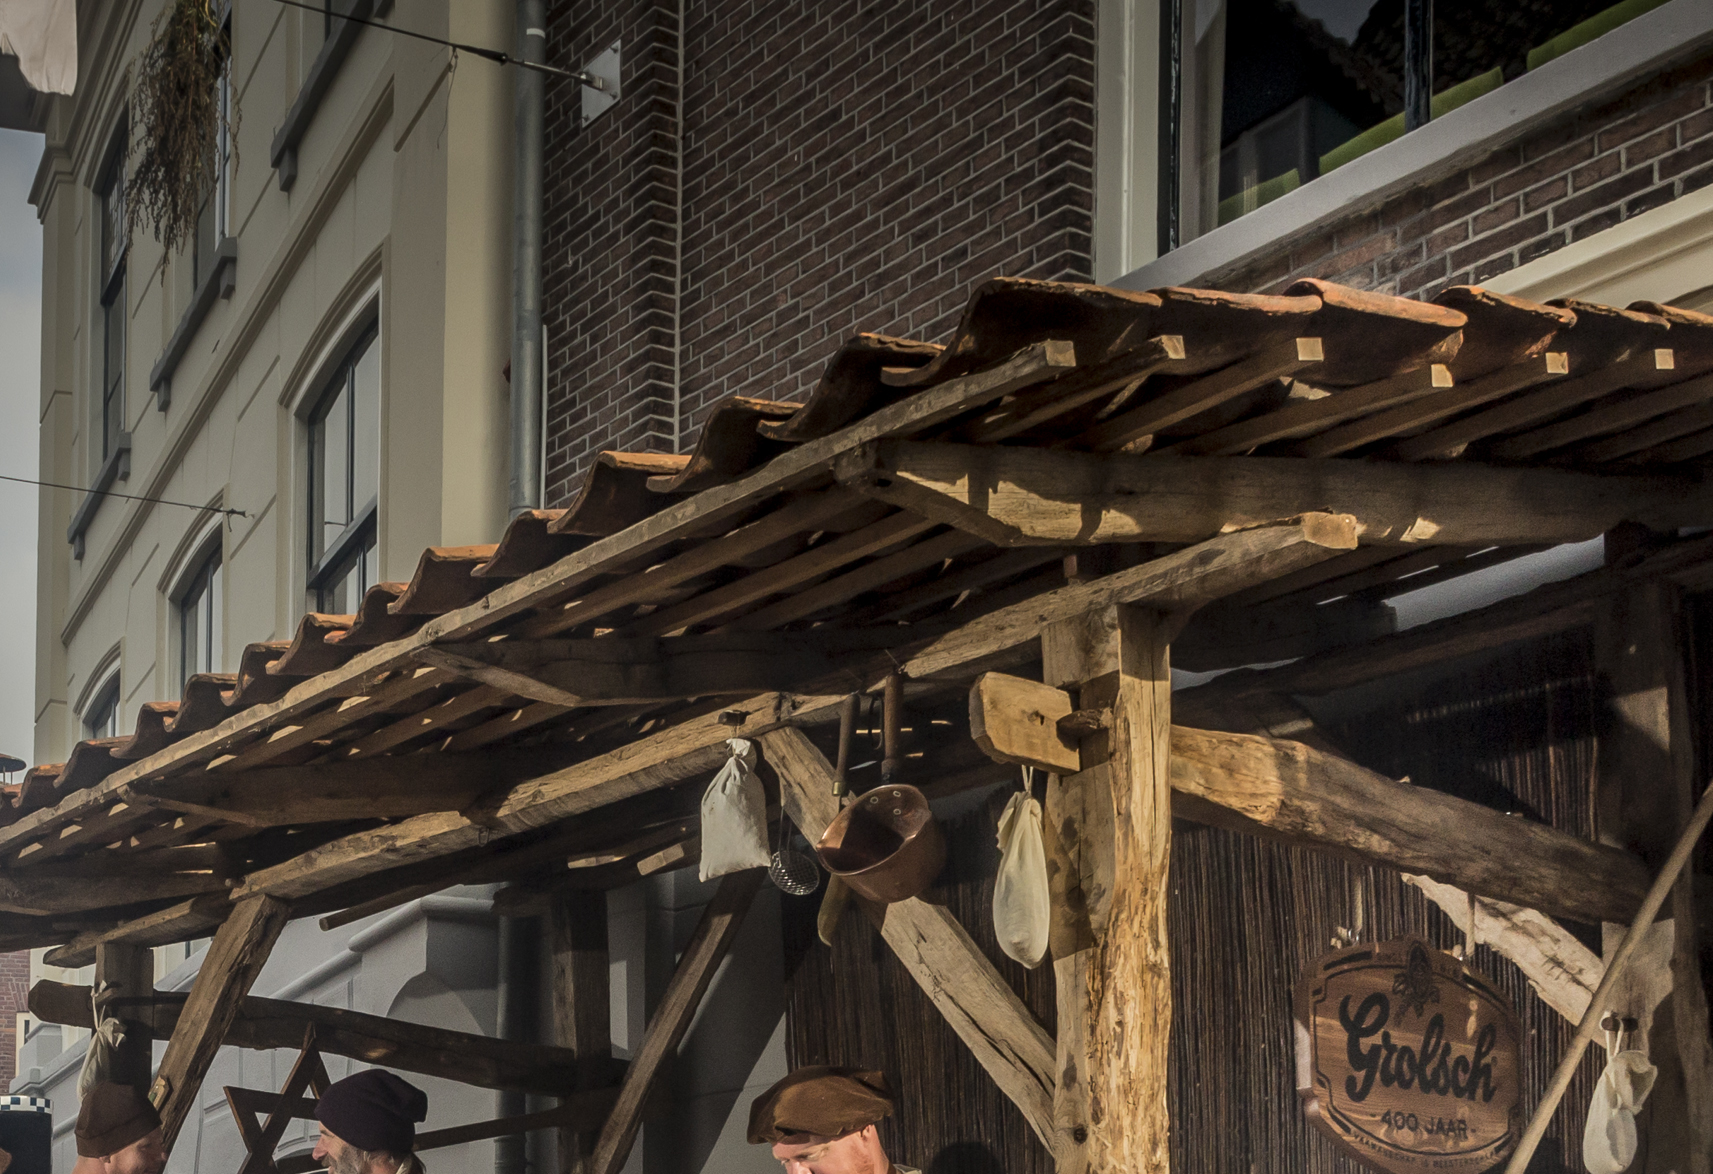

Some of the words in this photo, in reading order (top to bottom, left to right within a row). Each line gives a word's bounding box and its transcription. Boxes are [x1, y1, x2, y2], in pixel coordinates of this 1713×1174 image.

[1339, 992, 1497, 1103] Grolsch
[1381, 1109, 1418, 1132] 400
[1424, 1116, 1469, 1139] JAAR
